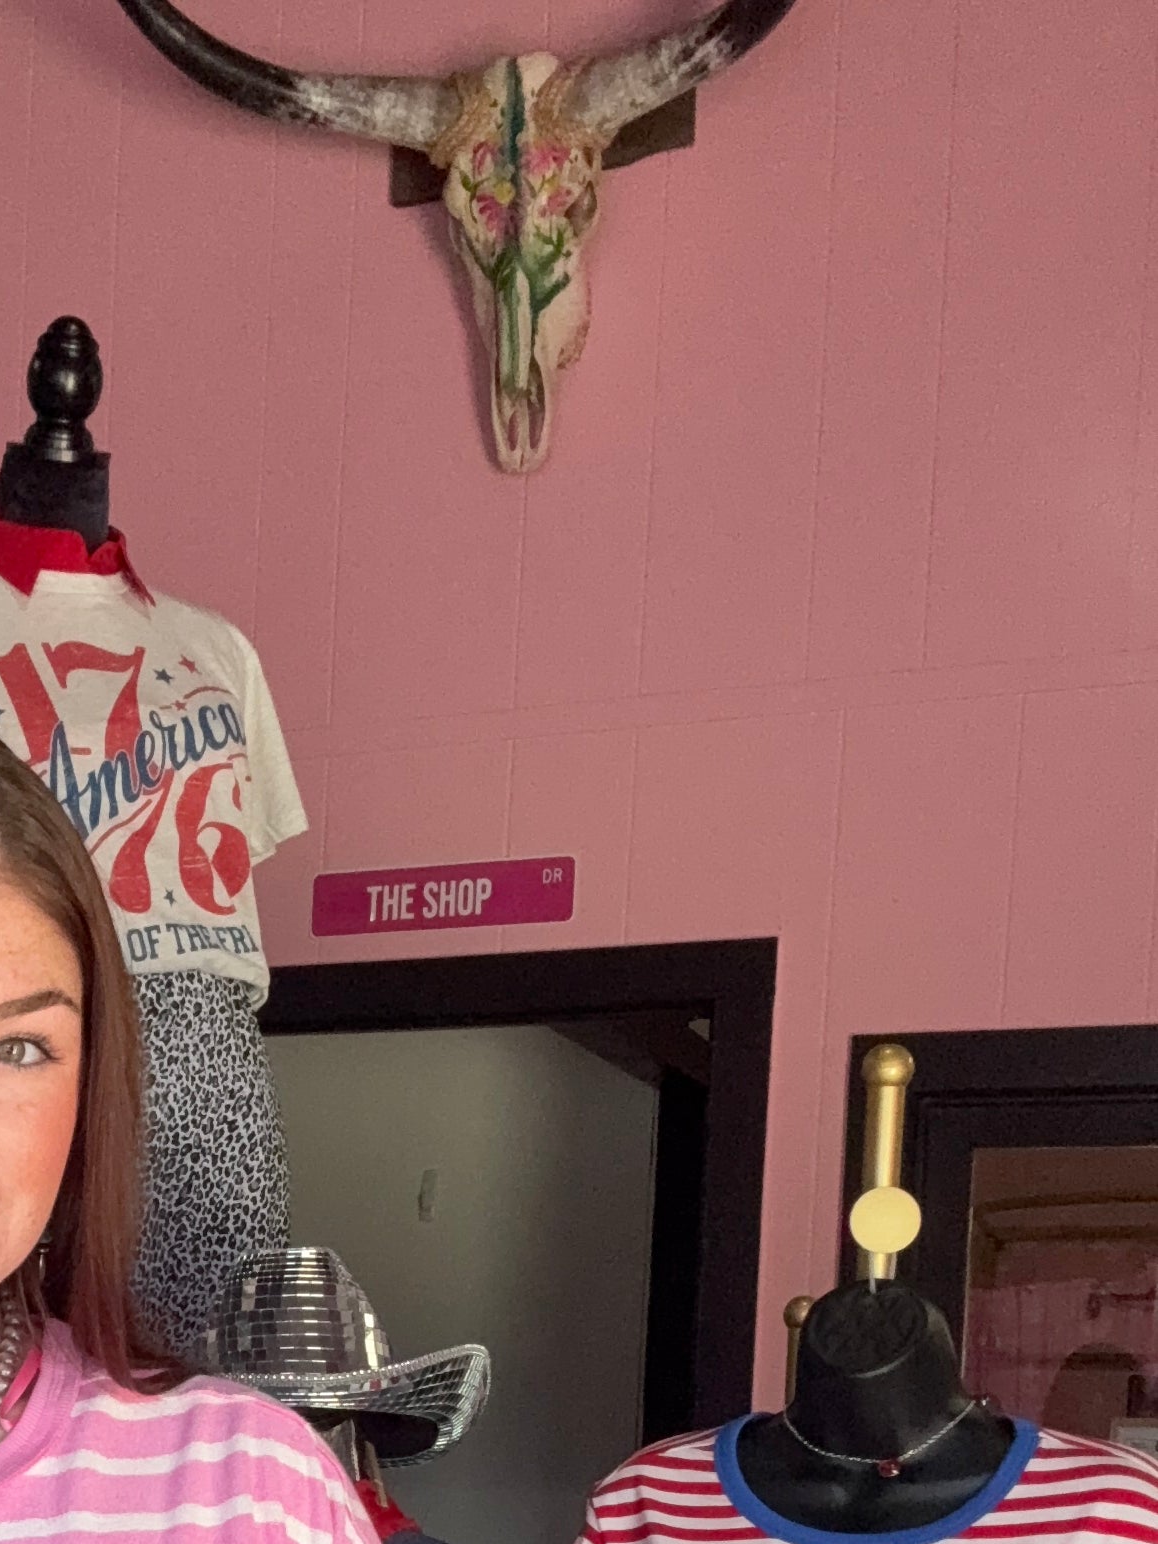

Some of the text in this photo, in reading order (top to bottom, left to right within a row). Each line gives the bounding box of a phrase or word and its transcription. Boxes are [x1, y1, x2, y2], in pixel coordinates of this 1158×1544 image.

[49, 702, 247, 842] America
[542, 866, 563, 885] DR
[366, 877, 493, 923] THE SHOP
[126, 924, 162, 962] OF
